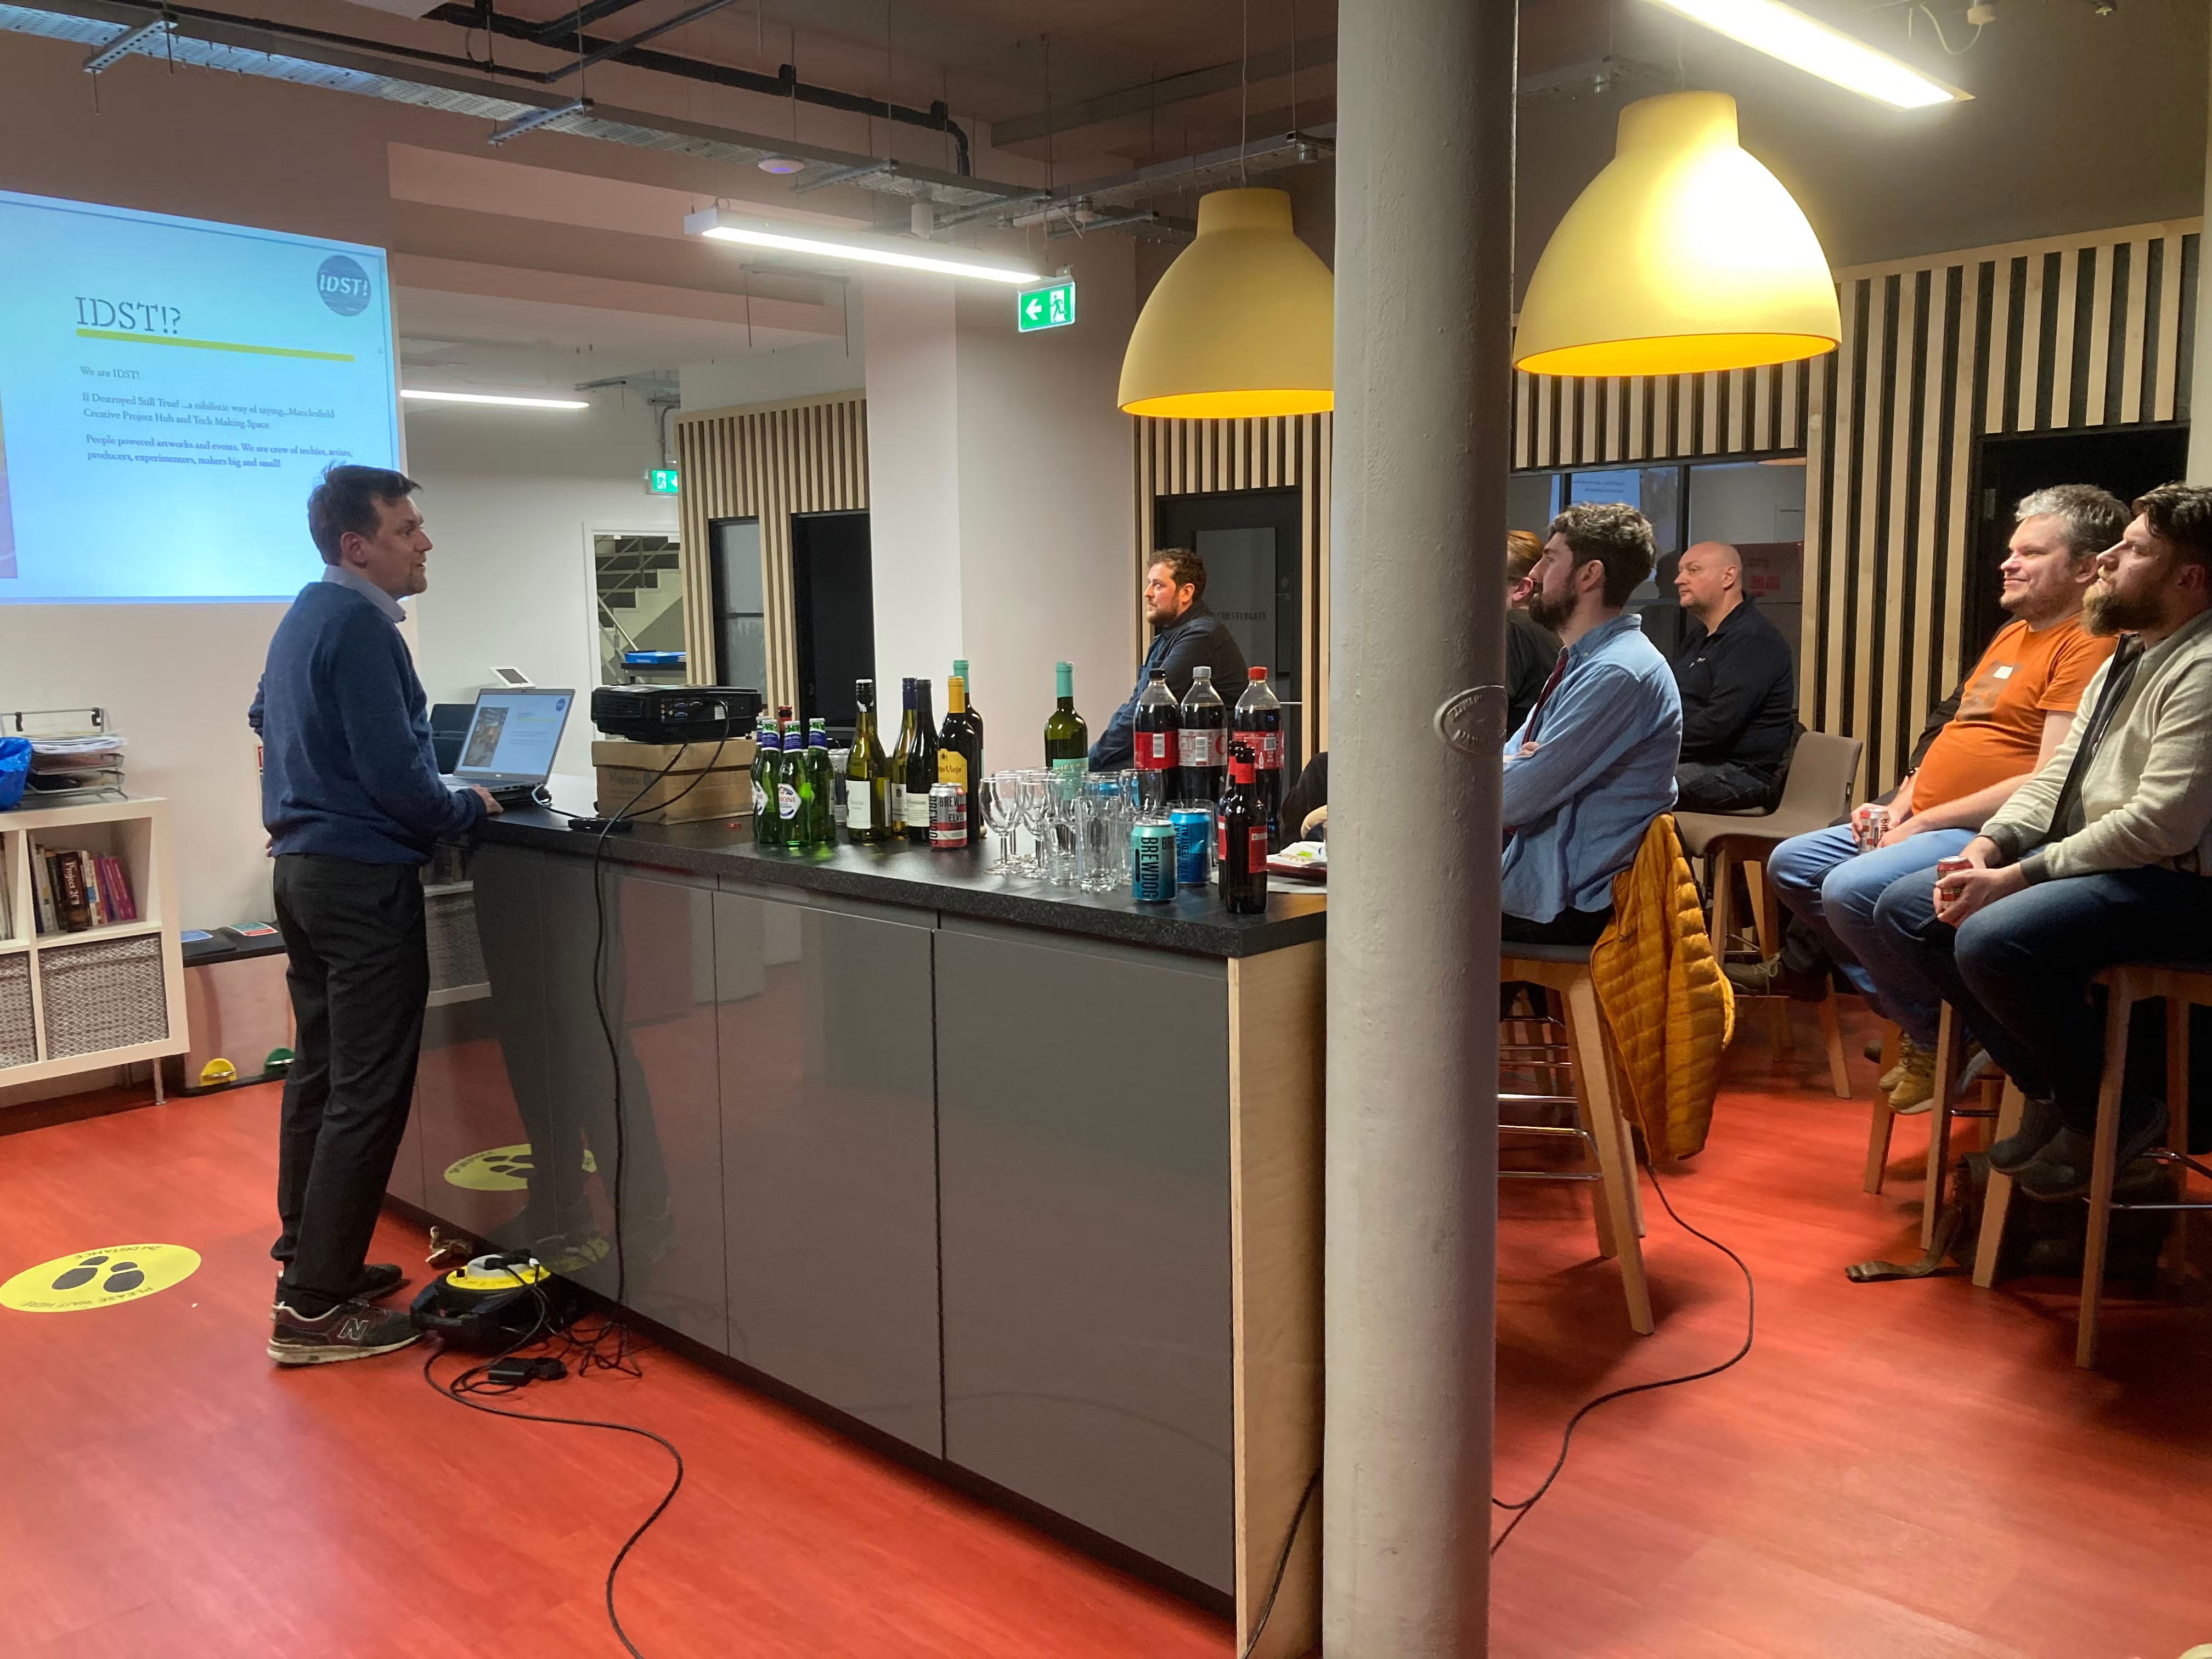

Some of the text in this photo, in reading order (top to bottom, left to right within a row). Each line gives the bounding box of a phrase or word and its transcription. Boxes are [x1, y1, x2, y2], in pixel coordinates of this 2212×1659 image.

[320, 275, 368, 297] IDST!
[75, 297, 181, 334] IDST!?
[80, 366, 94, 376] We
[113, 369, 140, 379] IDST!
[92, 393, 136, 406] Destroyed
[138, 397, 155, 406] Still
[157, 398, 179, 408] True!
[195, 400, 229, 411] nihilistic
[231, 406, 247, 414] way
[249, 404, 257, 413] of
[83, 409, 270, 430] Creative Project Hub and Tech Making Space
[87, 435, 116, 446] People
[117, 438, 155, 447] powered
[157, 439, 193, 449] artworks
[195, 441, 210, 449] and
[241, 443, 255, 452] We
[290, 445, 298, 454] of
[300, 446, 328, 456] techies,
[88, 450, 281, 468] producers, experimenters, makers big and small!
[946, 765, 962, 775] Viejo
[949, 813, 964, 822] ELVIS
[1181, 823, 1189, 837] ALL
[64, 862, 76, 889] Project
[1141, 837, 1159, 898] BREWDOG
[74, 1246, 139, 1260] DISTANCE
[98, 1287, 154, 1303] PLEASE
[337, 1317, 369, 1341] N
